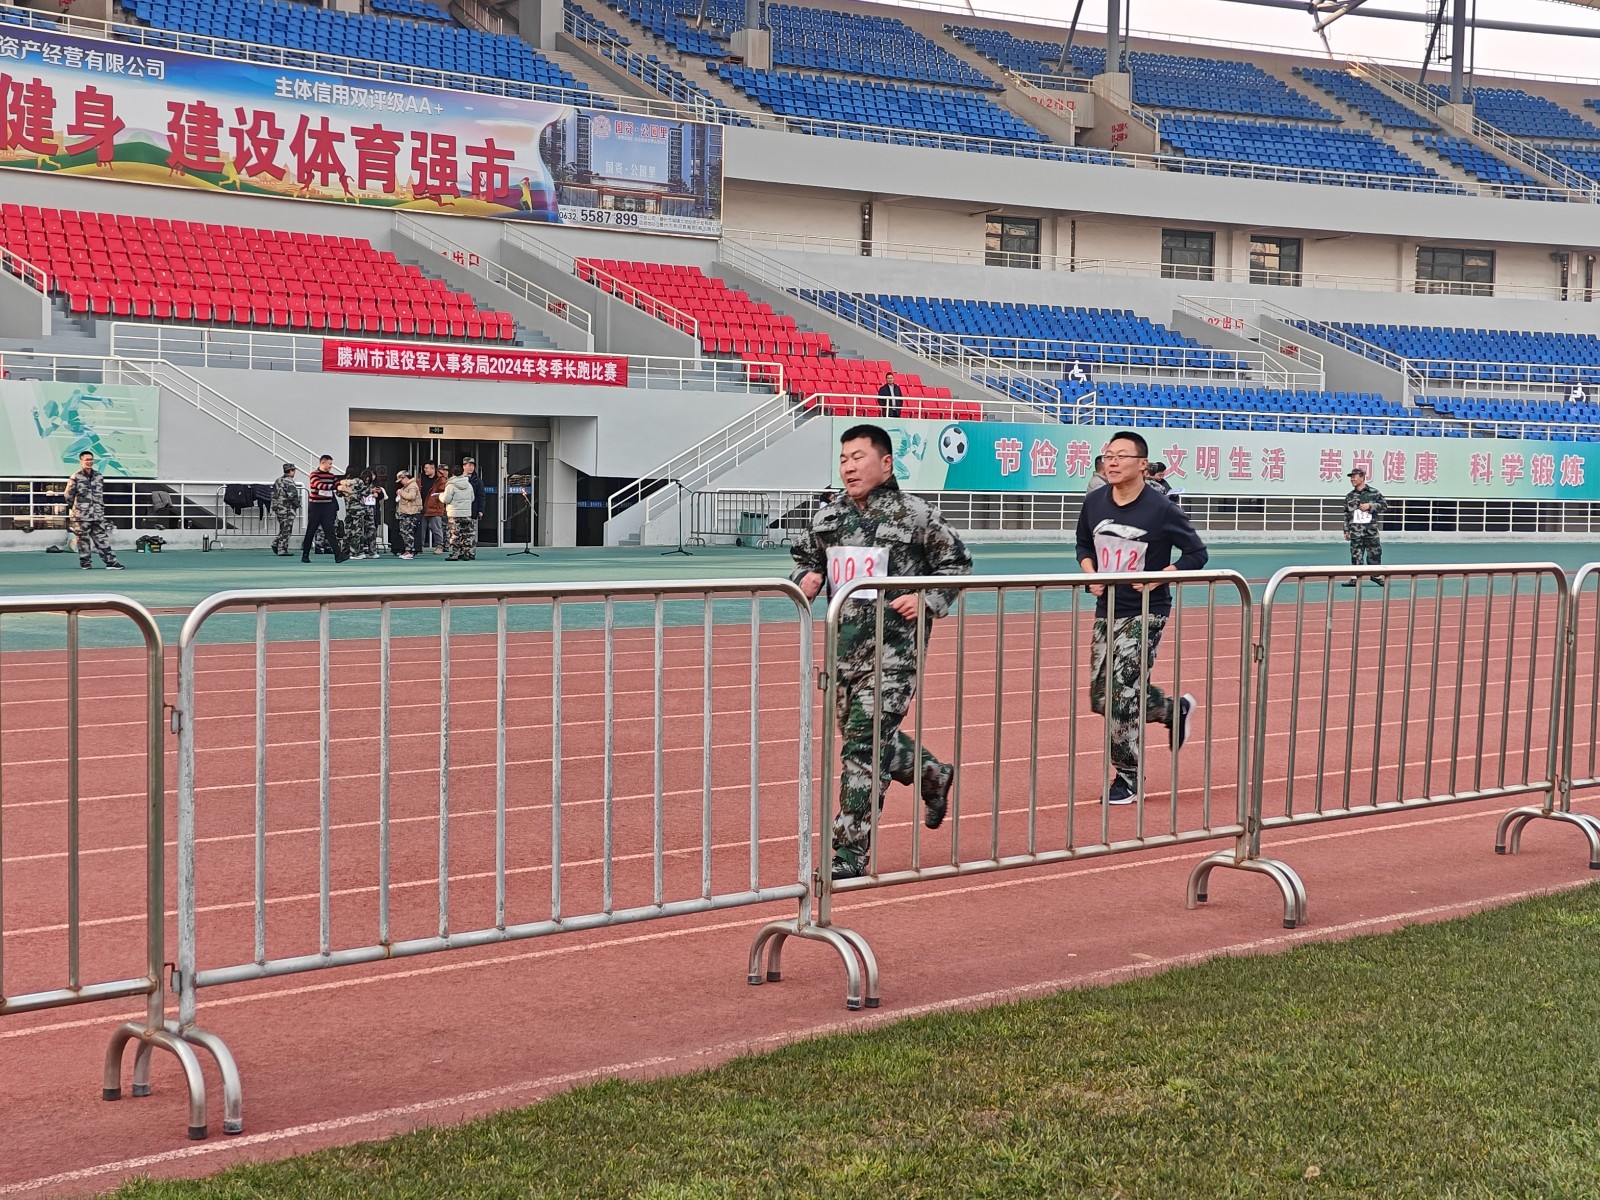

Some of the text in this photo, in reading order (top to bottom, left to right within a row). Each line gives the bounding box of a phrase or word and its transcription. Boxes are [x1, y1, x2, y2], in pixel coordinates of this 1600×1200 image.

[274, 76, 444, 115] 主体信用双评级AA+
[0, 72, 515, 202] 健身 建设体育强市
[559, 211, 577, 221] 0632
[581, 209, 611, 224] 5587
[615, 212, 638, 226] 899
[337, 346, 617, 383] 滕州市退役军人事务局2024年冬季长跑比赛
[994, 437, 1586, 487] 节俭养 文明生活 崇尚健康 科学锻炼
[832, 557, 875, 585] 003
[1101, 547, 1138, 571] 012
